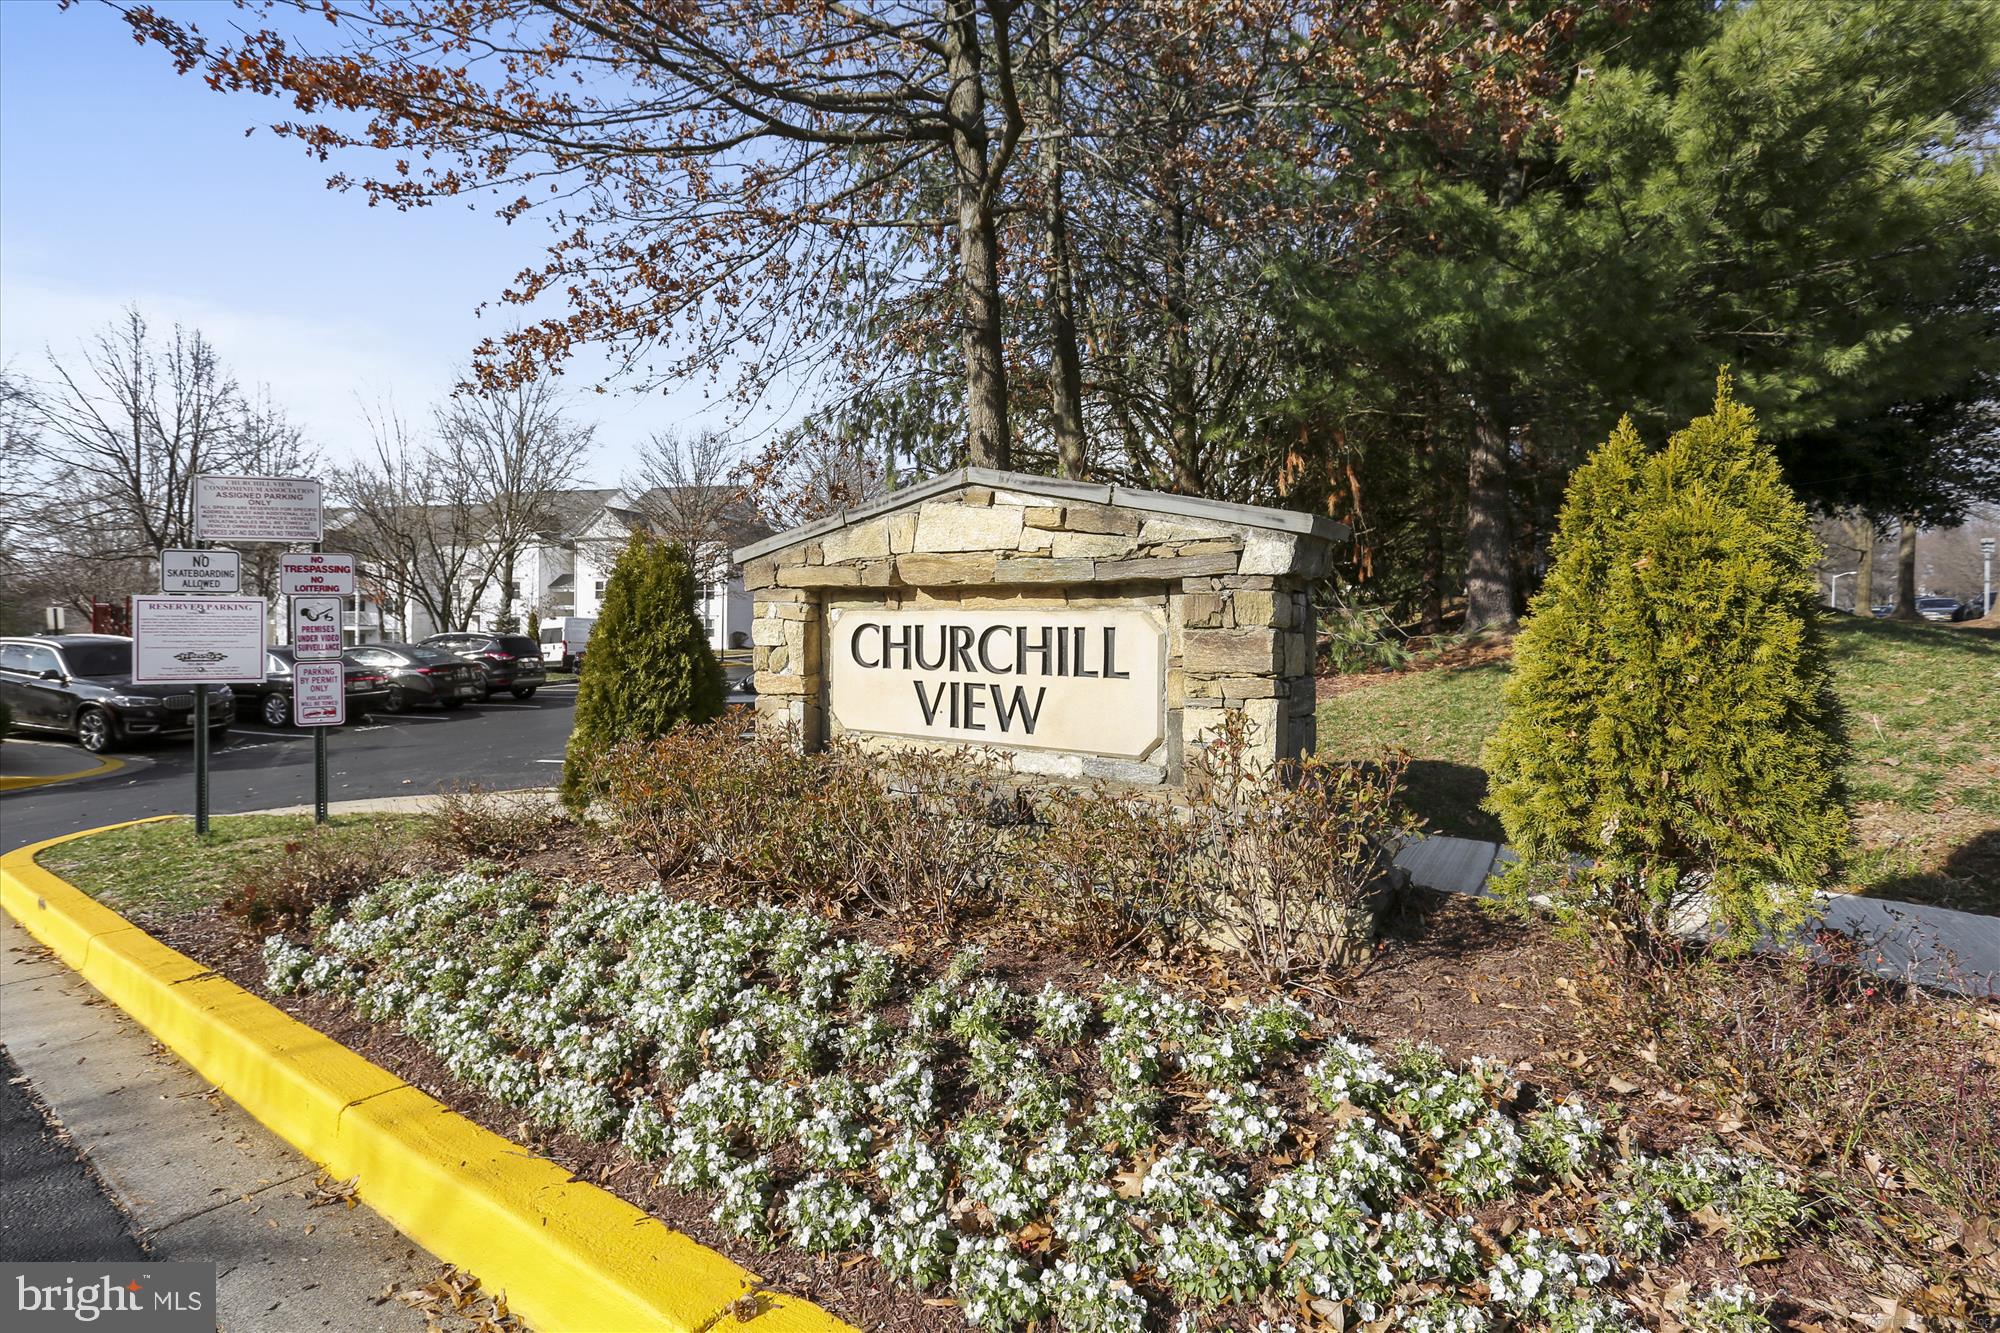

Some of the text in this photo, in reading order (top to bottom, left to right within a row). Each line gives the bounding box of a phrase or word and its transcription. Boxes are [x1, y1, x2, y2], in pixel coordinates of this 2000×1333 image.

[192, 556, 210, 568] NO
[310, 556, 324, 564] NO
[283, 564, 351, 574] TRESPASSING
[167, 569, 235, 578] SKATEBOARDING
[182, 580, 220, 588] ALLOWED
[310, 576, 324, 584] NO
[294, 584, 340, 592] LOITERING
[149, 603, 252, 612] RESERVED PARKING
[298, 634, 340, 642] UNDER VIDEO
[298, 644, 340, 652] SURVEILLANCE
[851, 623, 1130, 680] CHURCHILL
[312, 676, 338, 684] PERMIT
[310, 684, 328, 692] ONLY
[913, 680, 1046, 734] VIEW
